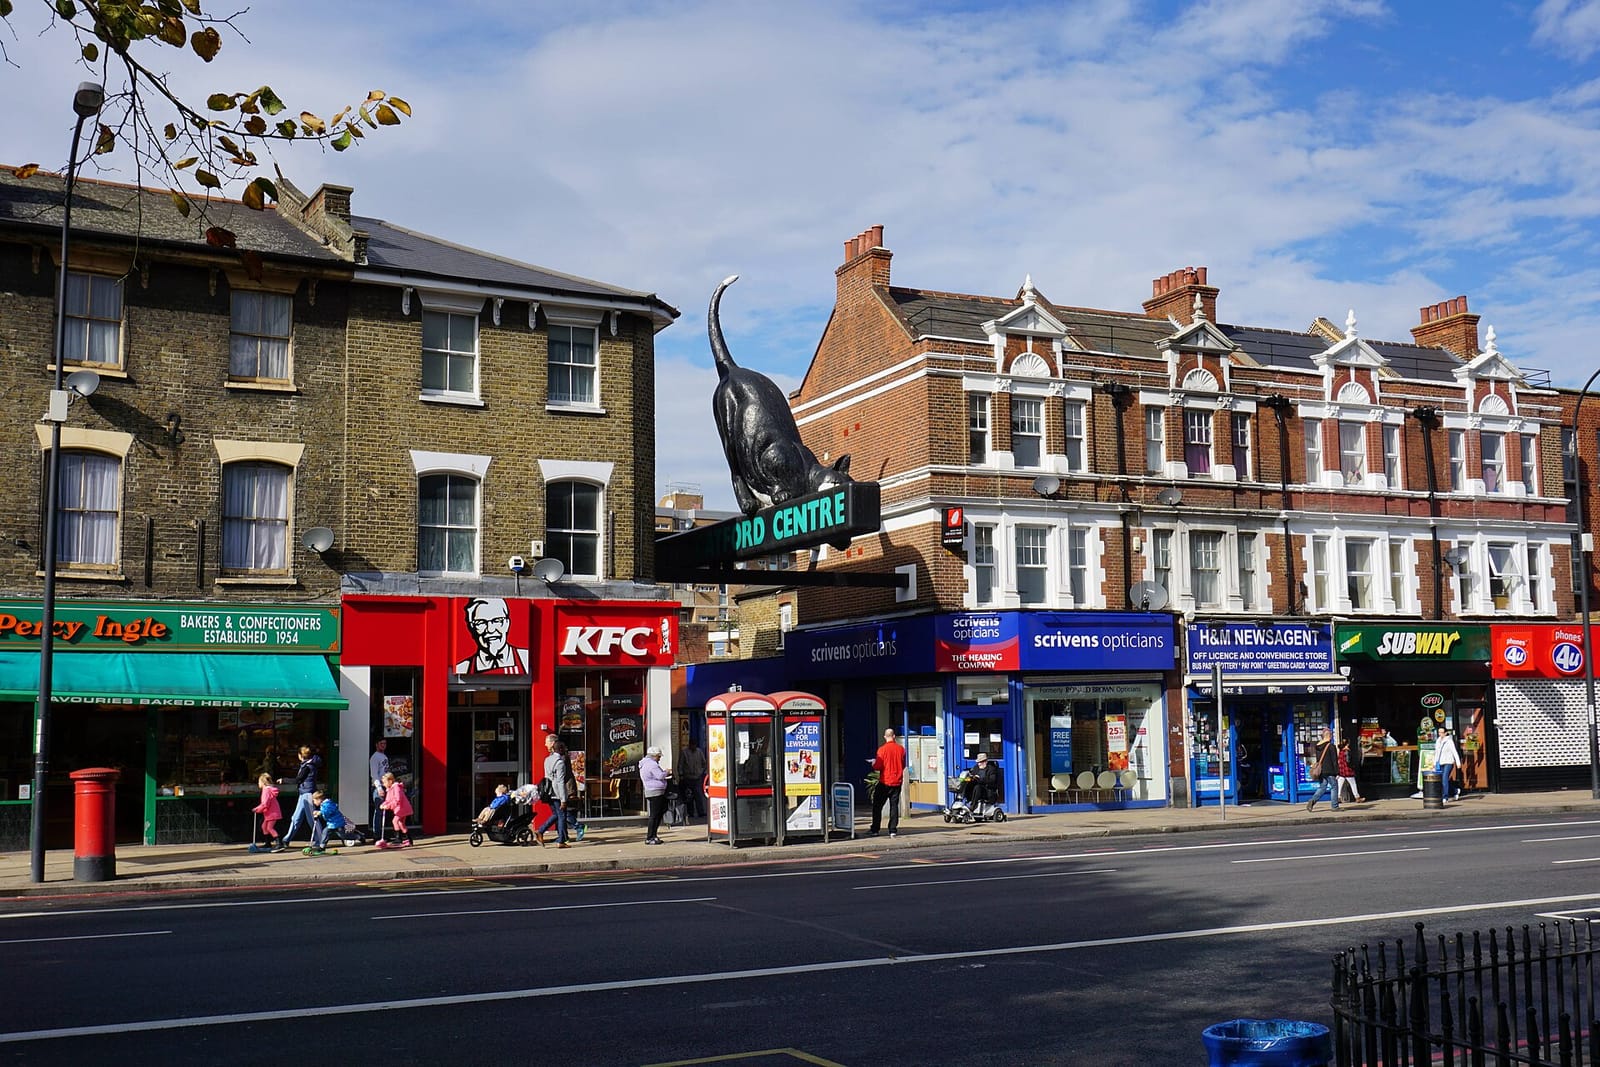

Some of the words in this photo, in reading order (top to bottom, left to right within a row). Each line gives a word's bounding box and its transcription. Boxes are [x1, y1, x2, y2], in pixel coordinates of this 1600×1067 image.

[772, 491, 846, 540] CENTRE
[0, 613, 83, 640] Percy
[92, 615, 167, 642] Ingle
[180, 615, 220, 629] BAKERS
[225, 616, 233, 629] &
[239, 616, 321, 631] CONFECTIONERS
[953, 616, 1000, 627] scrivens
[204, 630, 268, 644] ESTABLISHED
[276, 631, 299, 644] 1954
[953, 627, 1000, 640] opticians
[1200, 629, 1231, 646] H&M
[1234, 628, 1320, 646] NEWSAGENT
[1555, 629, 1582, 642] phones
[560, 626, 653, 656] KFC
[1034, 630, 1099, 648] scrivens
[1101, 632, 1164, 652] opticians
[1377, 630, 1460, 656] SUBWAY
[1506, 637, 1526, 646] phones
[811, 642, 851, 662] scrivens
[852, 637, 897, 663] opticians
[1193, 652, 1208, 660] OFF
[1208, 652, 1239, 660] LICENCE
[1239, 652, 1255, 660] AND
[1255, 652, 1304, 660] CONVENIENCE
[1304, 652, 1328, 660] STORE
[1506, 647, 1525, 663] 4u
[952, 654, 967, 662] THE
[968, 653, 1003, 661] HEARING
[1555, 645, 1580, 670] 4u
[958, 661, 996, 669] COMPANY
[1191, 662, 1202, 670] BUS
[1220, 662, 1238, 670] OTTERY
[1241, 662, 1250, 670] PAY
[1250, 662, 1264, 670] POINT
[1267, 662, 1289, 670] GREETING
[1290, 662, 1306, 670] CARDS
[1308, 662, 1329, 671] GROCERY
[140, 698, 195, 706] BAKED
[201, 699, 242, 707] HERE
[247, 701, 300, 709] TODAY
[1423, 696, 1441, 704] OPEN
[791, 725, 818, 735] OSTER
[1052, 731, 1070, 739] FREE
[785, 740, 819, 748] LEWISHAM
